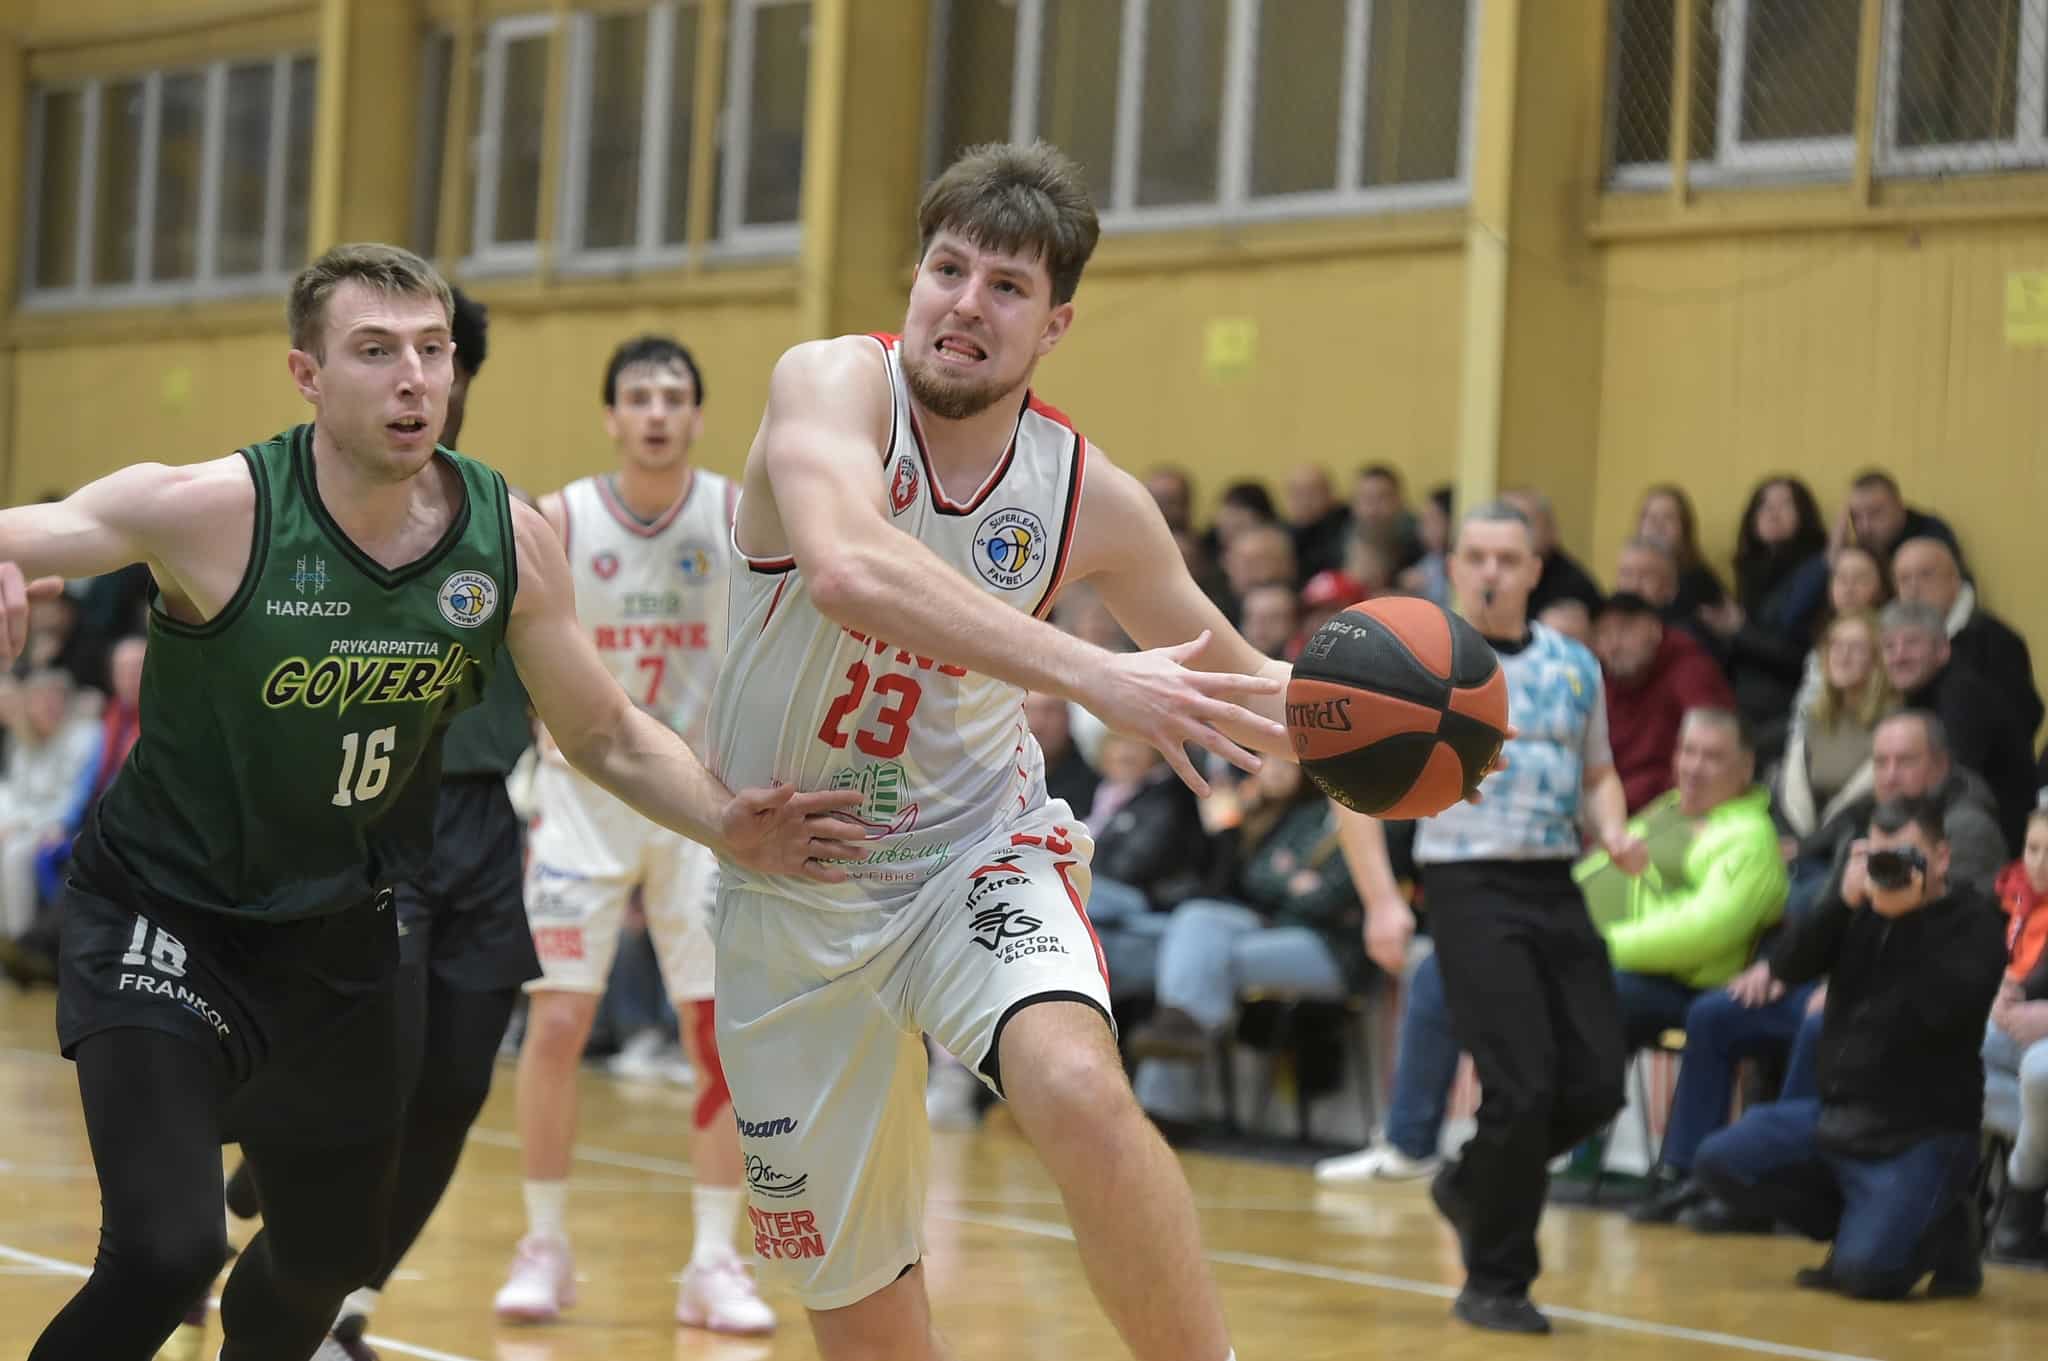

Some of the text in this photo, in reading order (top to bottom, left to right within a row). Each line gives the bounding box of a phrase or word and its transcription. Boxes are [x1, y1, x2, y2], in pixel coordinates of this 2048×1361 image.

[989, 513, 1042, 545] SUPERLEAGUE
[987, 567, 1023, 585] FAVBET
[266, 599, 351, 616] HARAZD
[329, 639, 439, 656] PRYKARPATTIA
[593, 622, 708, 650] RIVNE
[636, 655, 666, 706] 7
[817, 660, 922, 759] 23
[331, 726, 397, 807] 16
[995, 935, 1059, 960] VECTOR
[1004, 945, 1070, 964] GLOBAL
